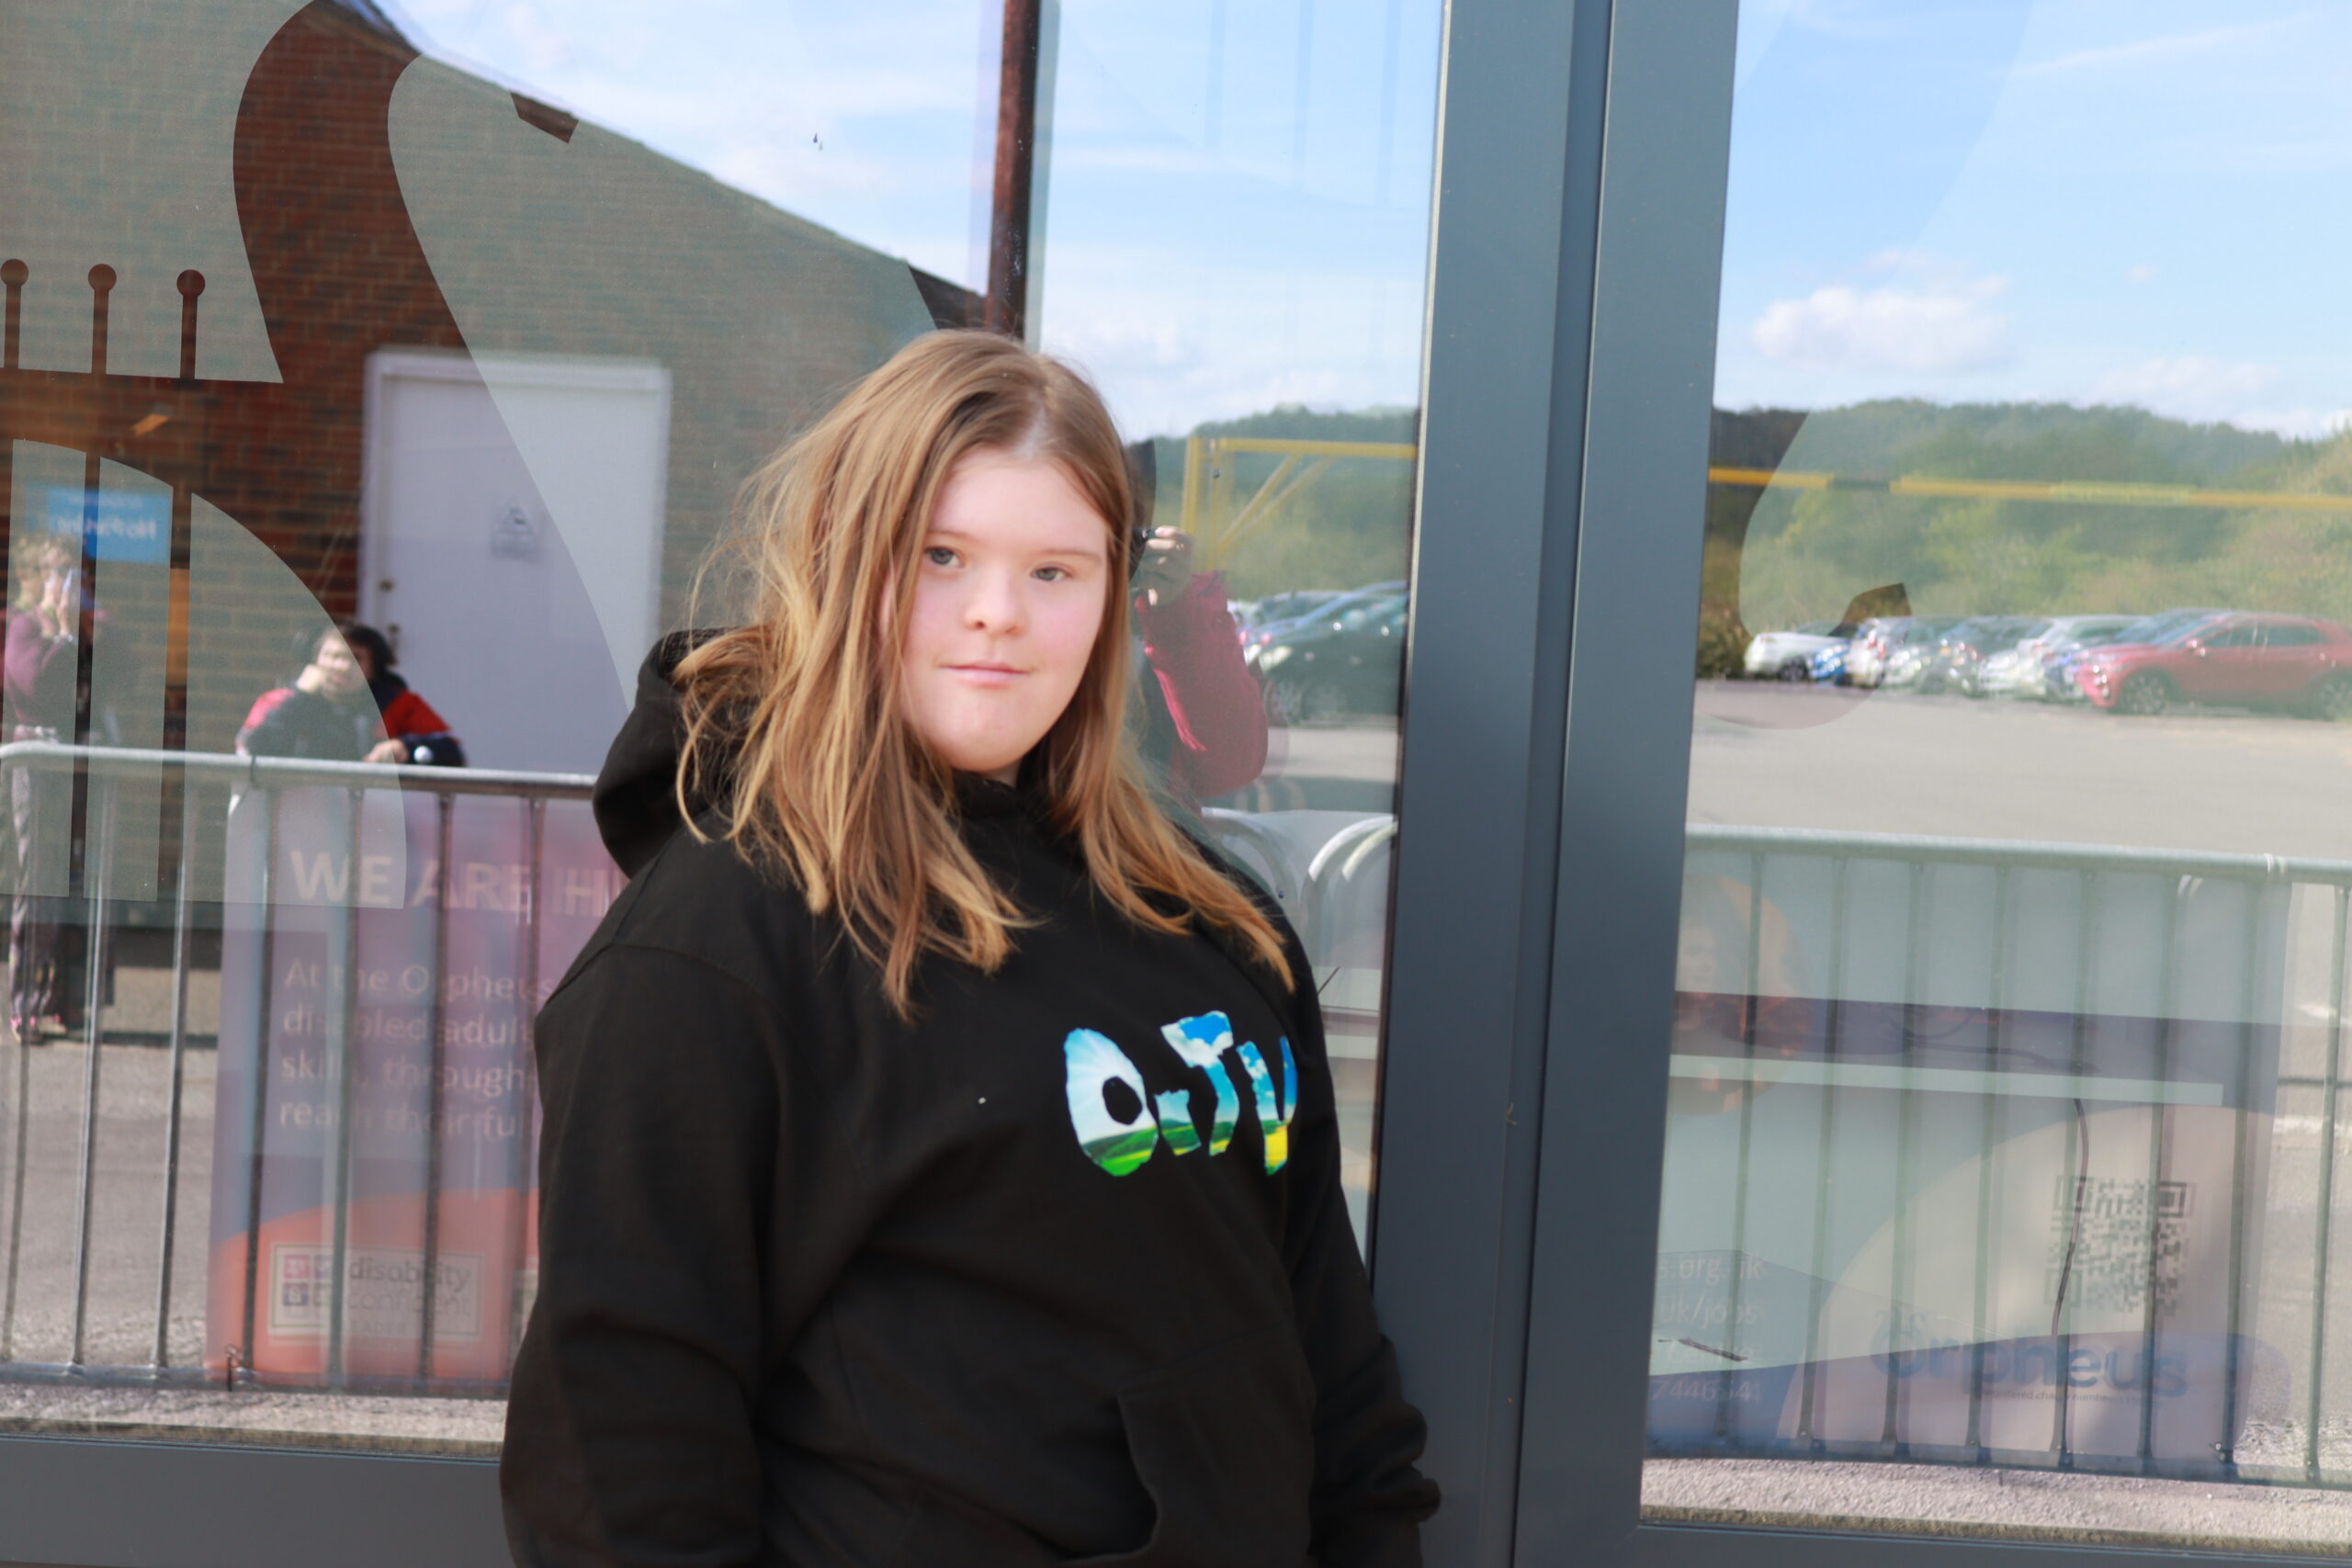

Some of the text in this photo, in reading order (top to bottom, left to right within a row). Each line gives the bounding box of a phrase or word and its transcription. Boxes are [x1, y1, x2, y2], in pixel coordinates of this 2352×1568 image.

[289, 850, 393, 904] WE
[410, 858, 530, 913] ARE
[284, 956, 322, 988] At
[399, 964, 559, 1003] Opheus
[282, 999, 427, 1045] disbled
[278, 1099, 373, 1134] reah
[382, 1100, 471, 1137] thir
[349, 1255, 472, 1292] disabity
